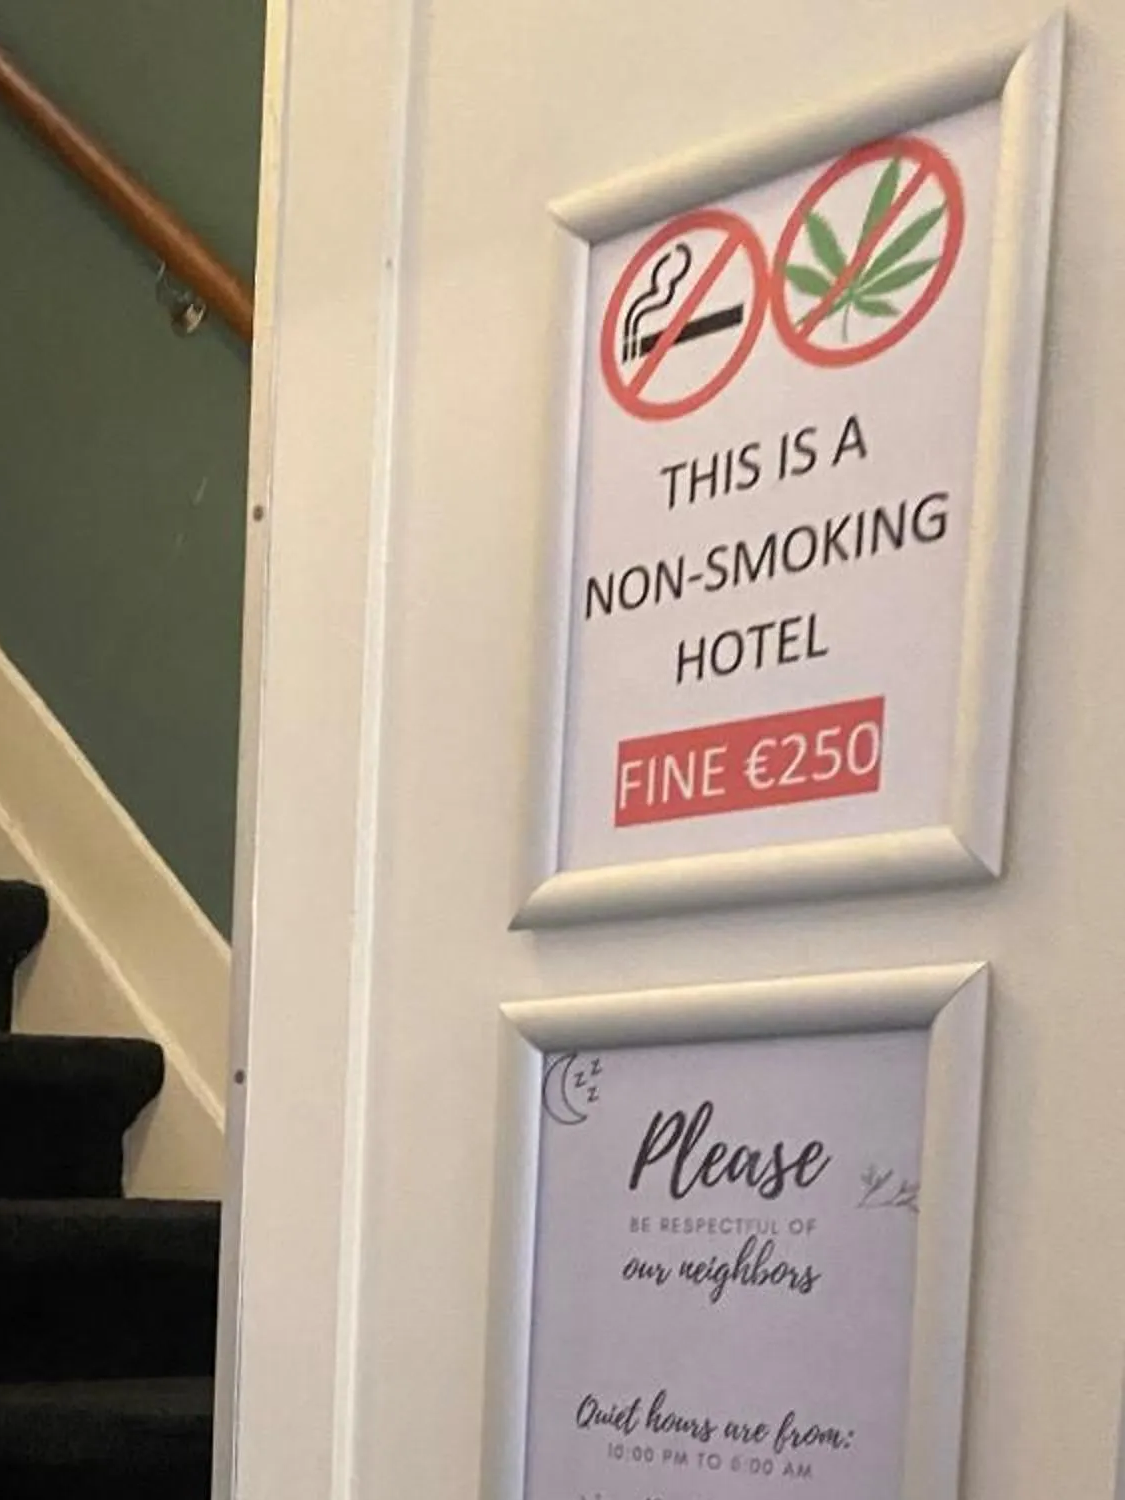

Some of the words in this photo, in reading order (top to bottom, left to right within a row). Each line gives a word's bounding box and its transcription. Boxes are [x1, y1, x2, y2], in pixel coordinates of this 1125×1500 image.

[660, 440, 761, 511] THIS
[777, 426, 818, 482] IS
[831, 413, 868, 467] A
[583, 491, 951, 621] NON-SMOKING
[675, 613, 829, 685] HOTEL
[617, 744, 728, 809] FINE
[743, 720, 880, 792] €250
[628, 1100, 831, 1200] Please
[629, 1216, 651, 1233] BE
[659, 1216, 778, 1235] RESPECTFUL
[788, 1217, 817, 1235] OF
[622, 1257, 672, 1286] our
[678, 1234, 822, 1304] neighbors
[576, 1394, 642, 1435] Quiet
[645, 1389, 717, 1442] hours
[724, 1419, 770, 1442] are
[773, 1411, 855, 1454] from:
[662, 1449, 688, 1465] PM
[698, 1452, 722, 1471] TO
[782, 1461, 813, 1479] AM
